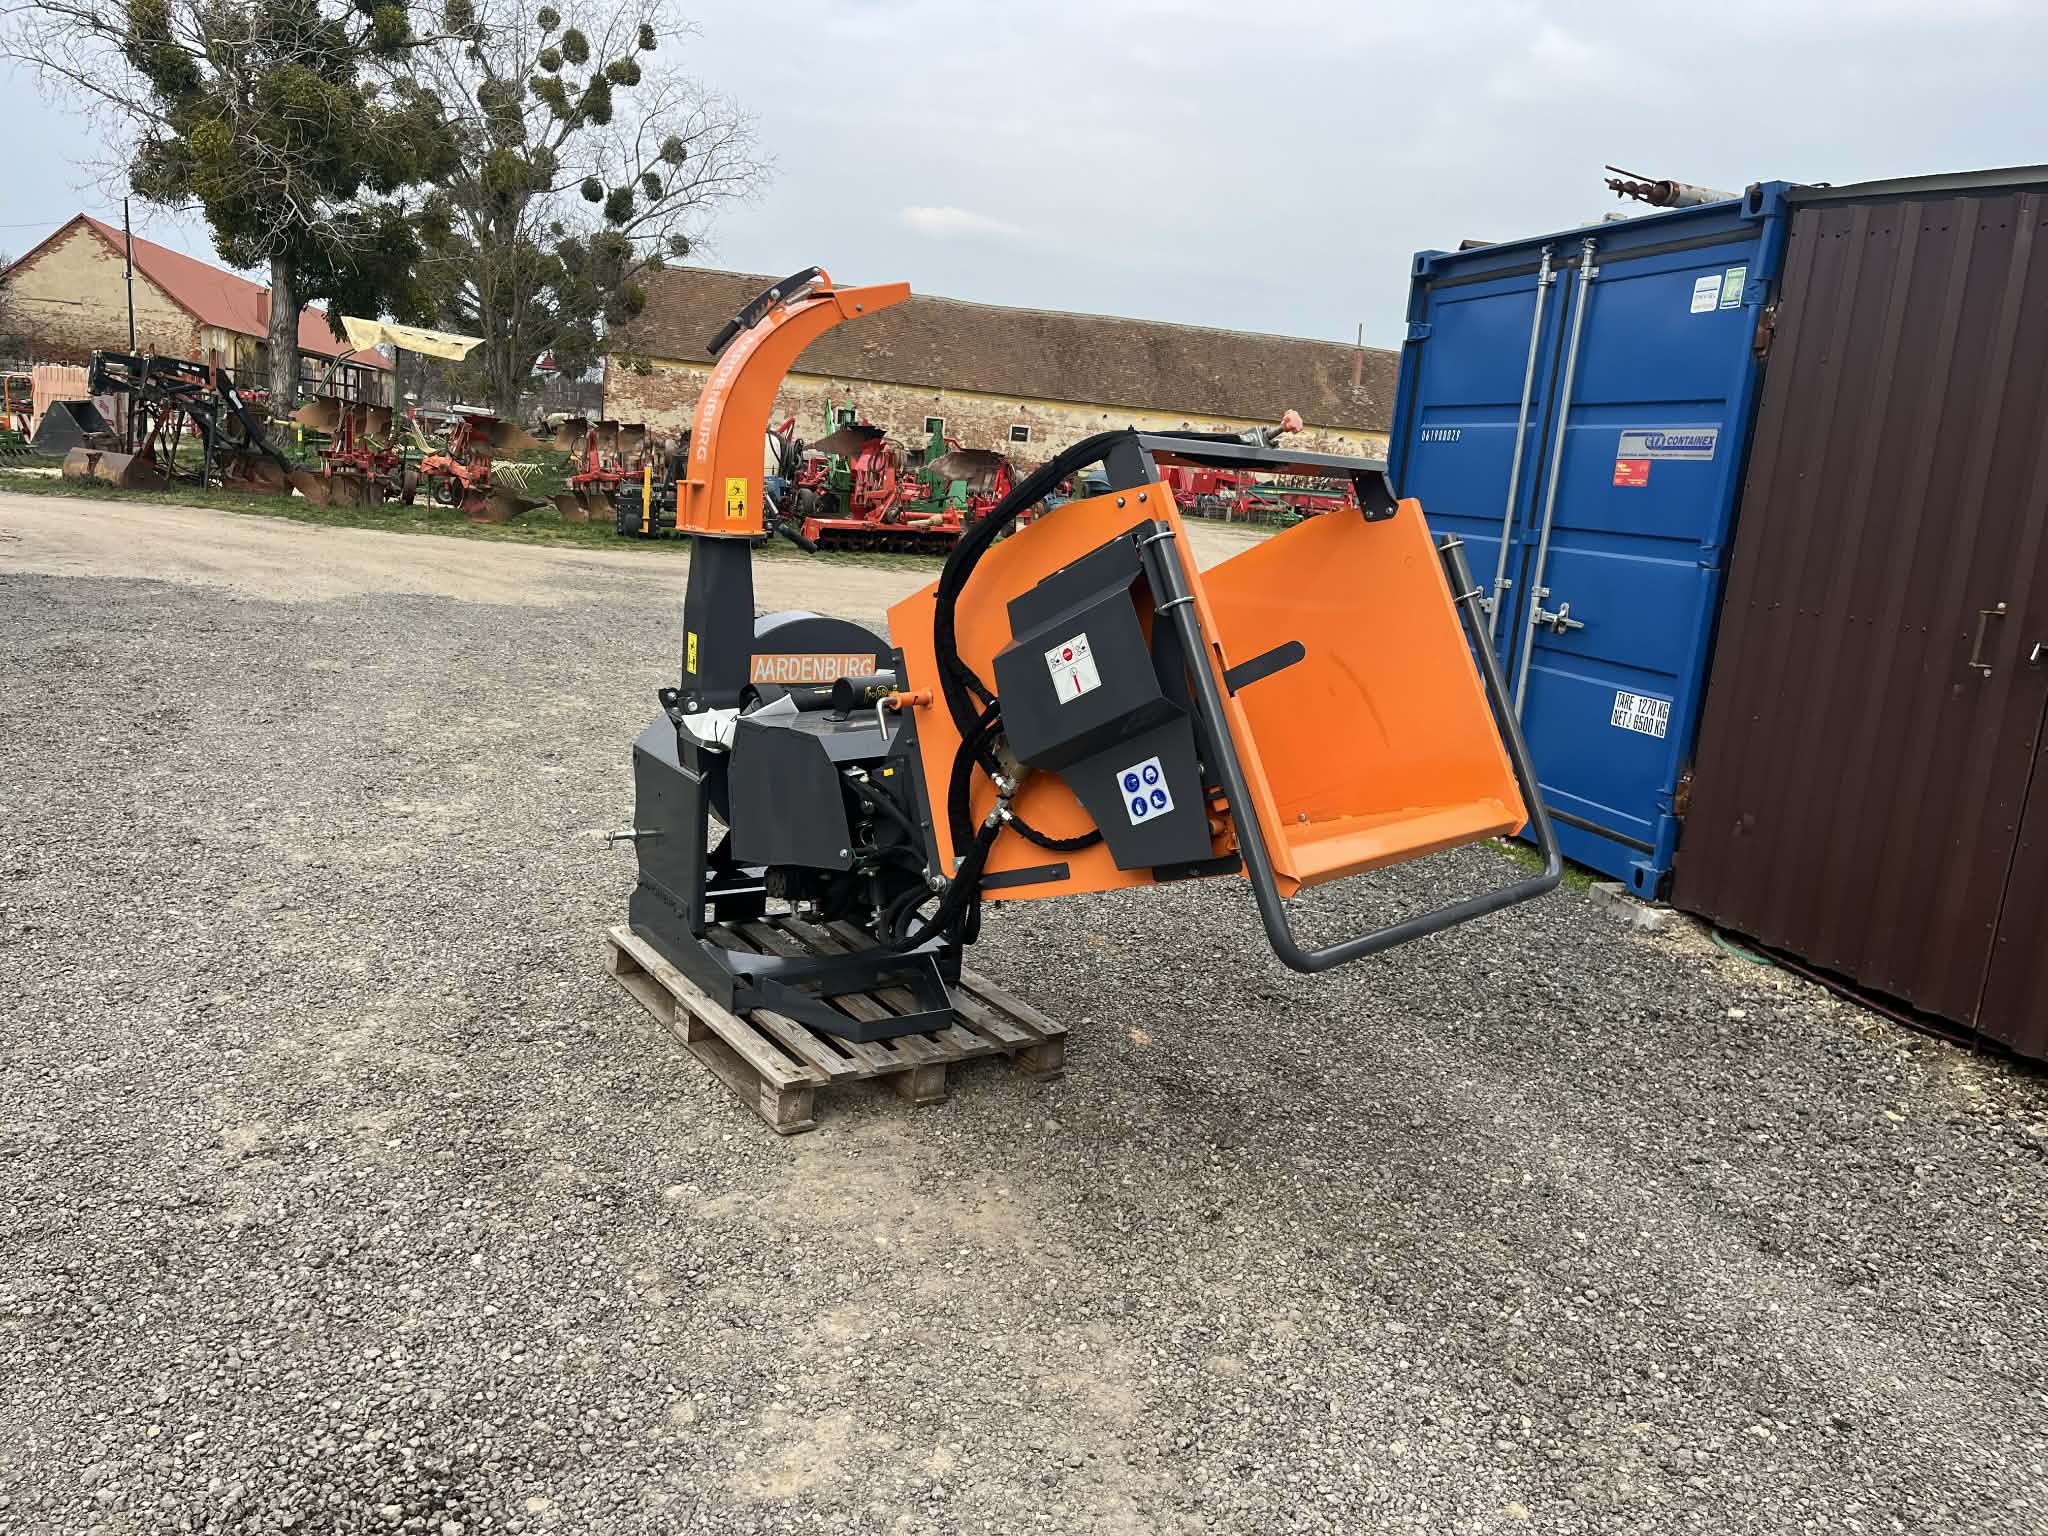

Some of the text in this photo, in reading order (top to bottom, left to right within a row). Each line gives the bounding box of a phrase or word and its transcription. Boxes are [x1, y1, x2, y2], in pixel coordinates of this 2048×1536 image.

[1667, 436, 1715, 446] CONTAINEX
[753, 657, 872, 681] AARDENBURG
[1616, 692, 1669, 720] TARE 1270 KG
[1633, 714, 1654, 733] 6500
[1654, 719, 1666, 737] KG
